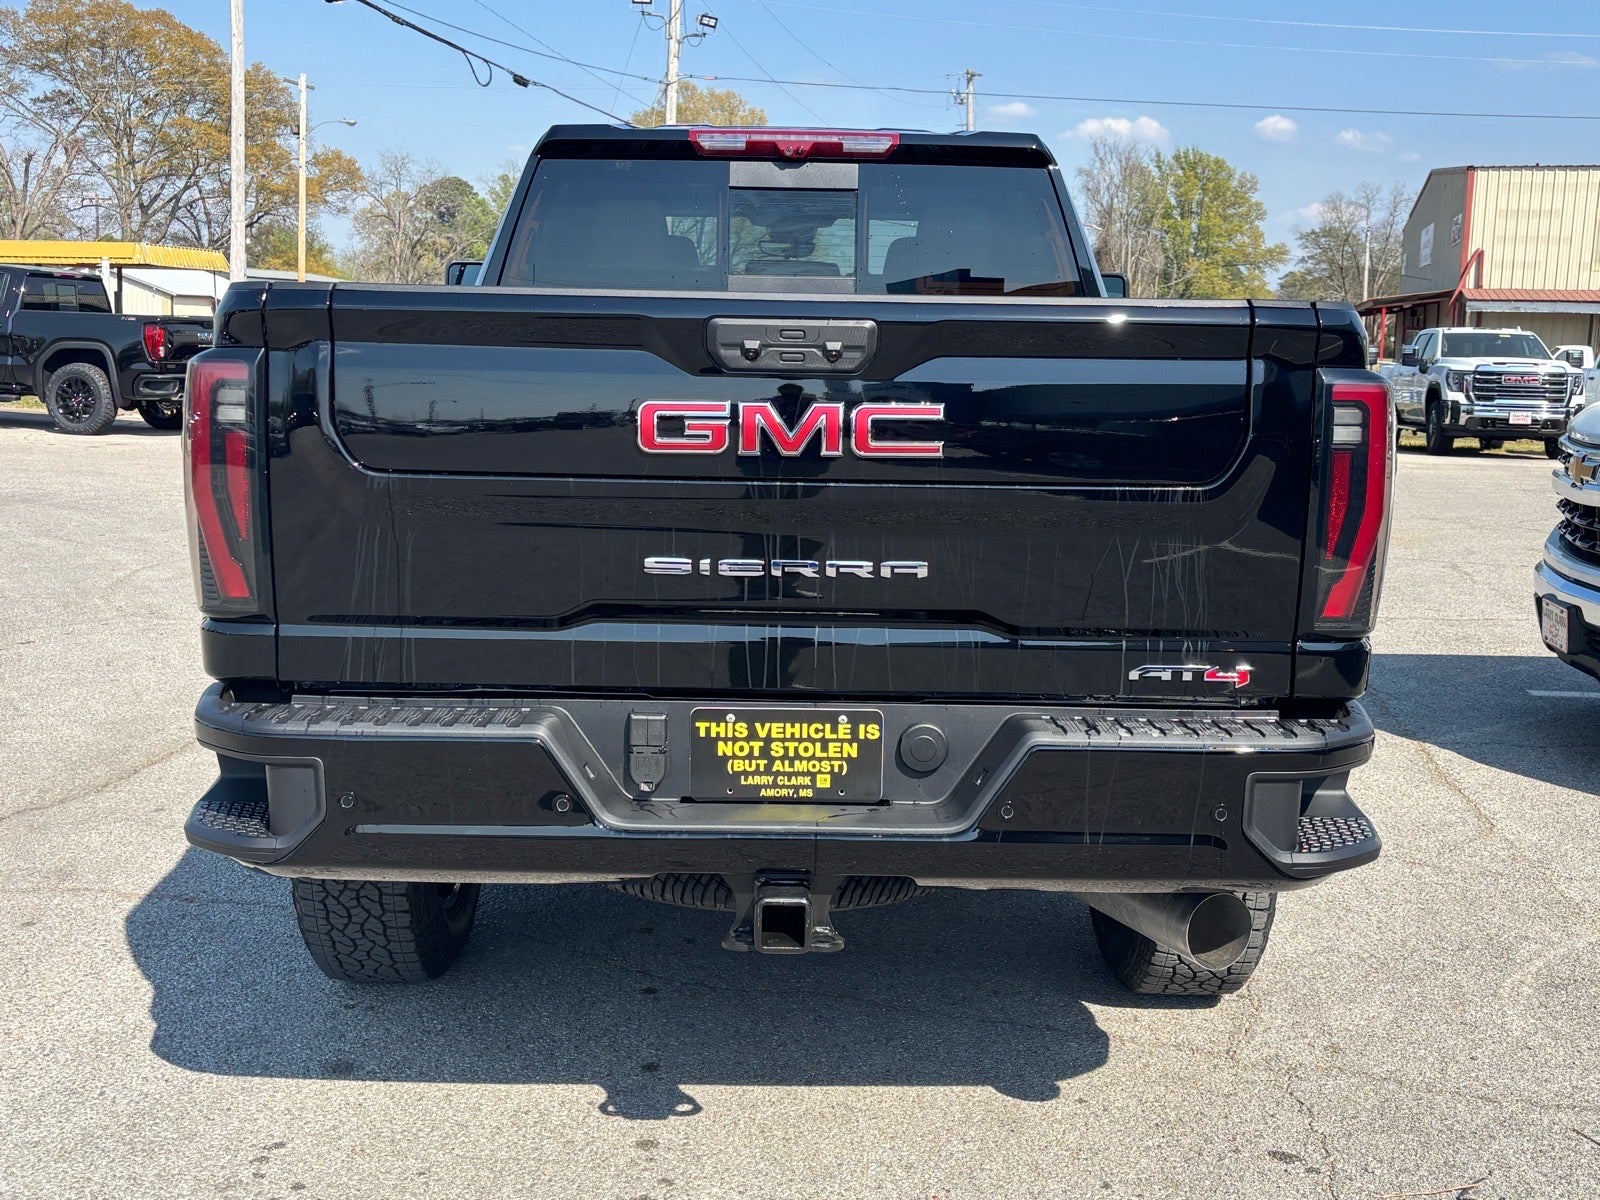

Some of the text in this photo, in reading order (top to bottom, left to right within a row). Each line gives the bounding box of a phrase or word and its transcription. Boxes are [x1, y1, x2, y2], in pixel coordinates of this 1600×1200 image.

[637, 400, 945, 459] GMC
[643, 556, 929, 579] SIERRA
[1128, 664, 1252, 689] AT4
[695, 721, 881, 740] THIS VEHICLE IS
[717, 741, 858, 758] NOT STOLEN
[727, 759, 848, 776] (BUT ALMOST)
[740, 775, 775, 786] LARRY
[777, 776, 812, 786] CLARK
[759, 788, 814, 799] AMORY, MS
